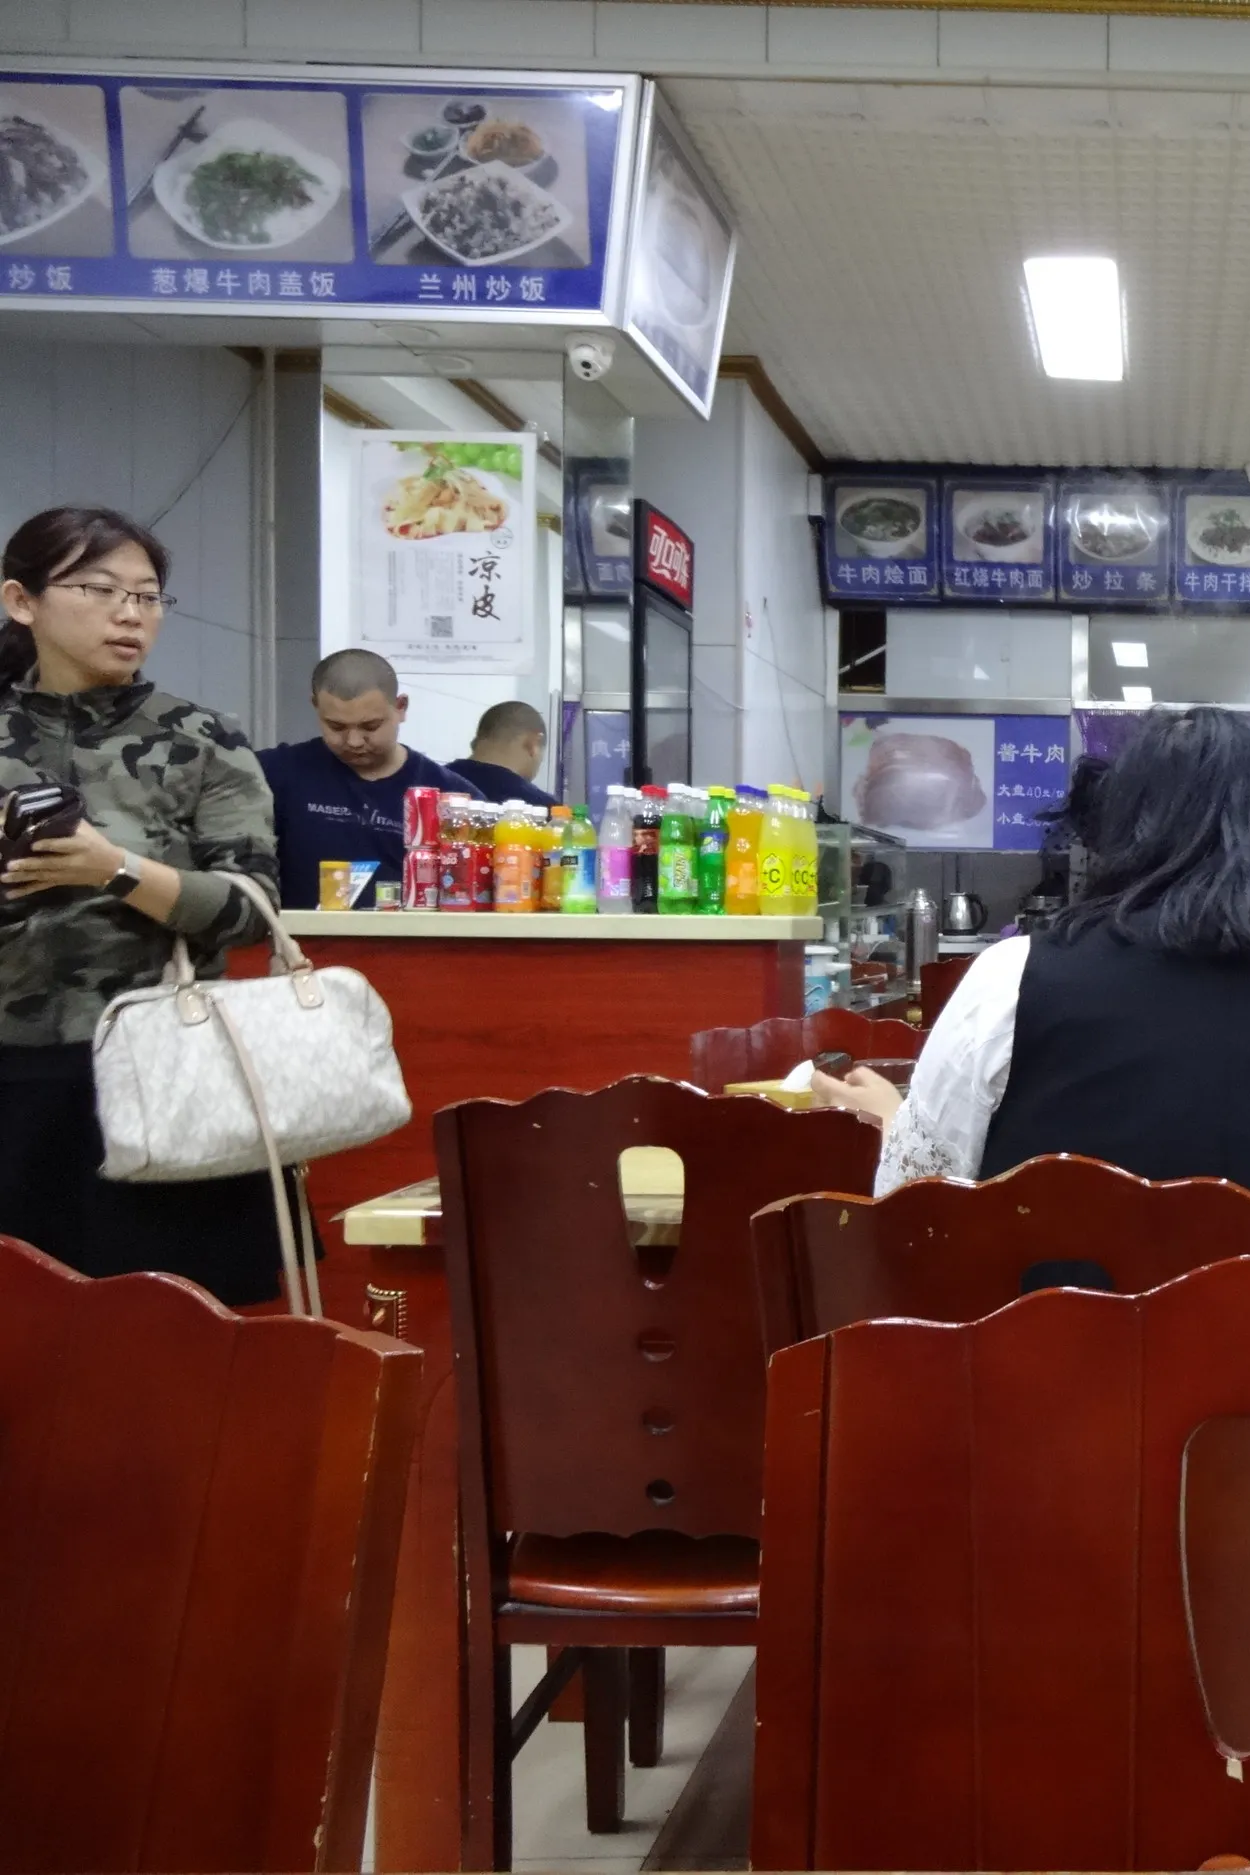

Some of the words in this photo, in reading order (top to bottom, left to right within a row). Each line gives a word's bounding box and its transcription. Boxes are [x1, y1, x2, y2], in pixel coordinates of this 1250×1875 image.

[8, 263, 73, 291] 炒饭
[151, 267, 337, 298] 葱爆牛肉盖饭
[418, 273, 547, 302] 兰州炒饭
[468, 550, 502, 621] 凉皮
[837, 564, 929, 587] 牛肉烩面
[953, 567, 1045, 590] 红烧牛肉面
[997, 742, 1065, 764] 酱牛肉
